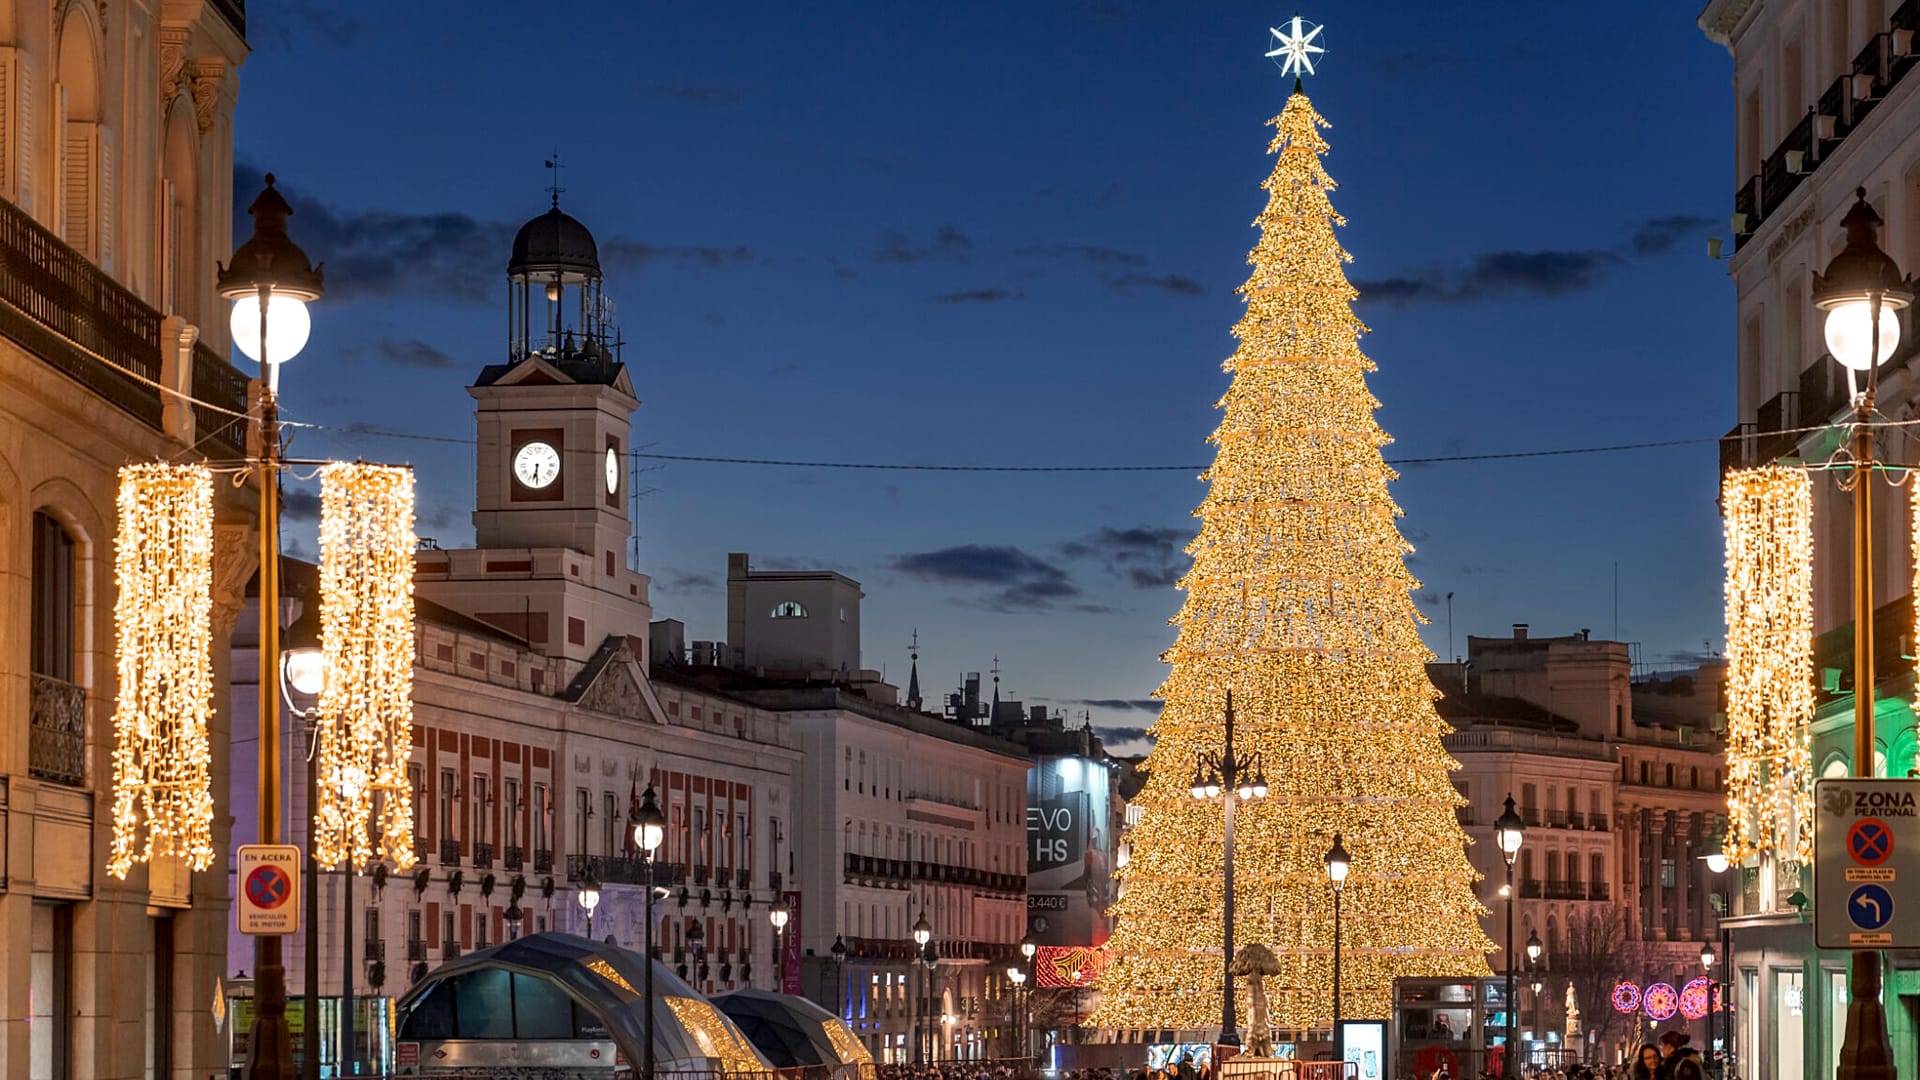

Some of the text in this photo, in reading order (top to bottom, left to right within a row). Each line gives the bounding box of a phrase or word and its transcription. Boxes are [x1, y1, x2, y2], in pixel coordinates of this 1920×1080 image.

[1855, 791, 1916, 807] ZONA
[1854, 807, 1917, 817] PEATONAL
[1036, 838, 1067, 861] HS
